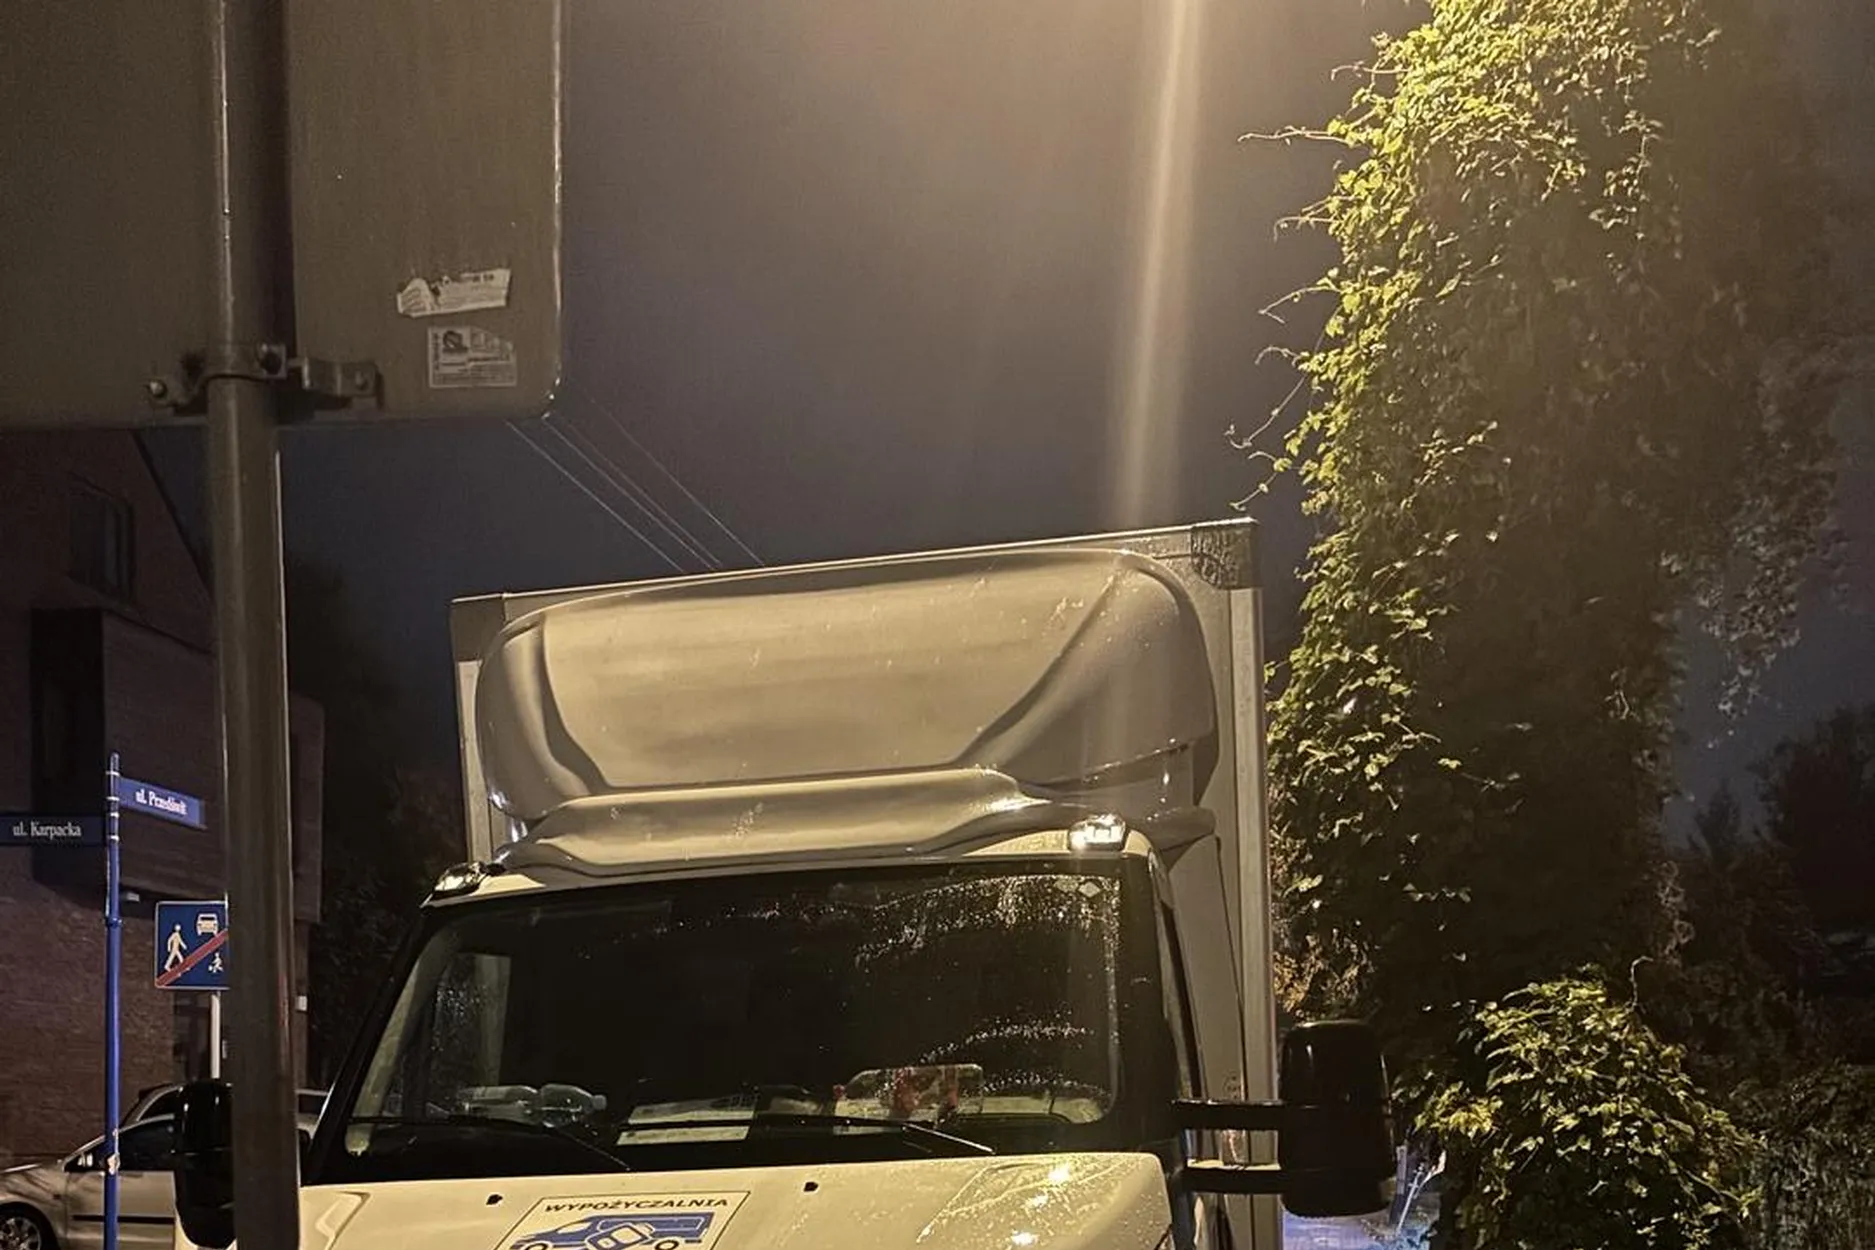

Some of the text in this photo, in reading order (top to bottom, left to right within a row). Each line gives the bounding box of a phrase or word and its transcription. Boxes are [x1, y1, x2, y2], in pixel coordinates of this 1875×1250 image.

[135, 788, 147, 804] ul.
[13, 821, 81, 840] ul. Karpacka
[545, 1198, 729, 1212] WYPOŻYCZALNIA
